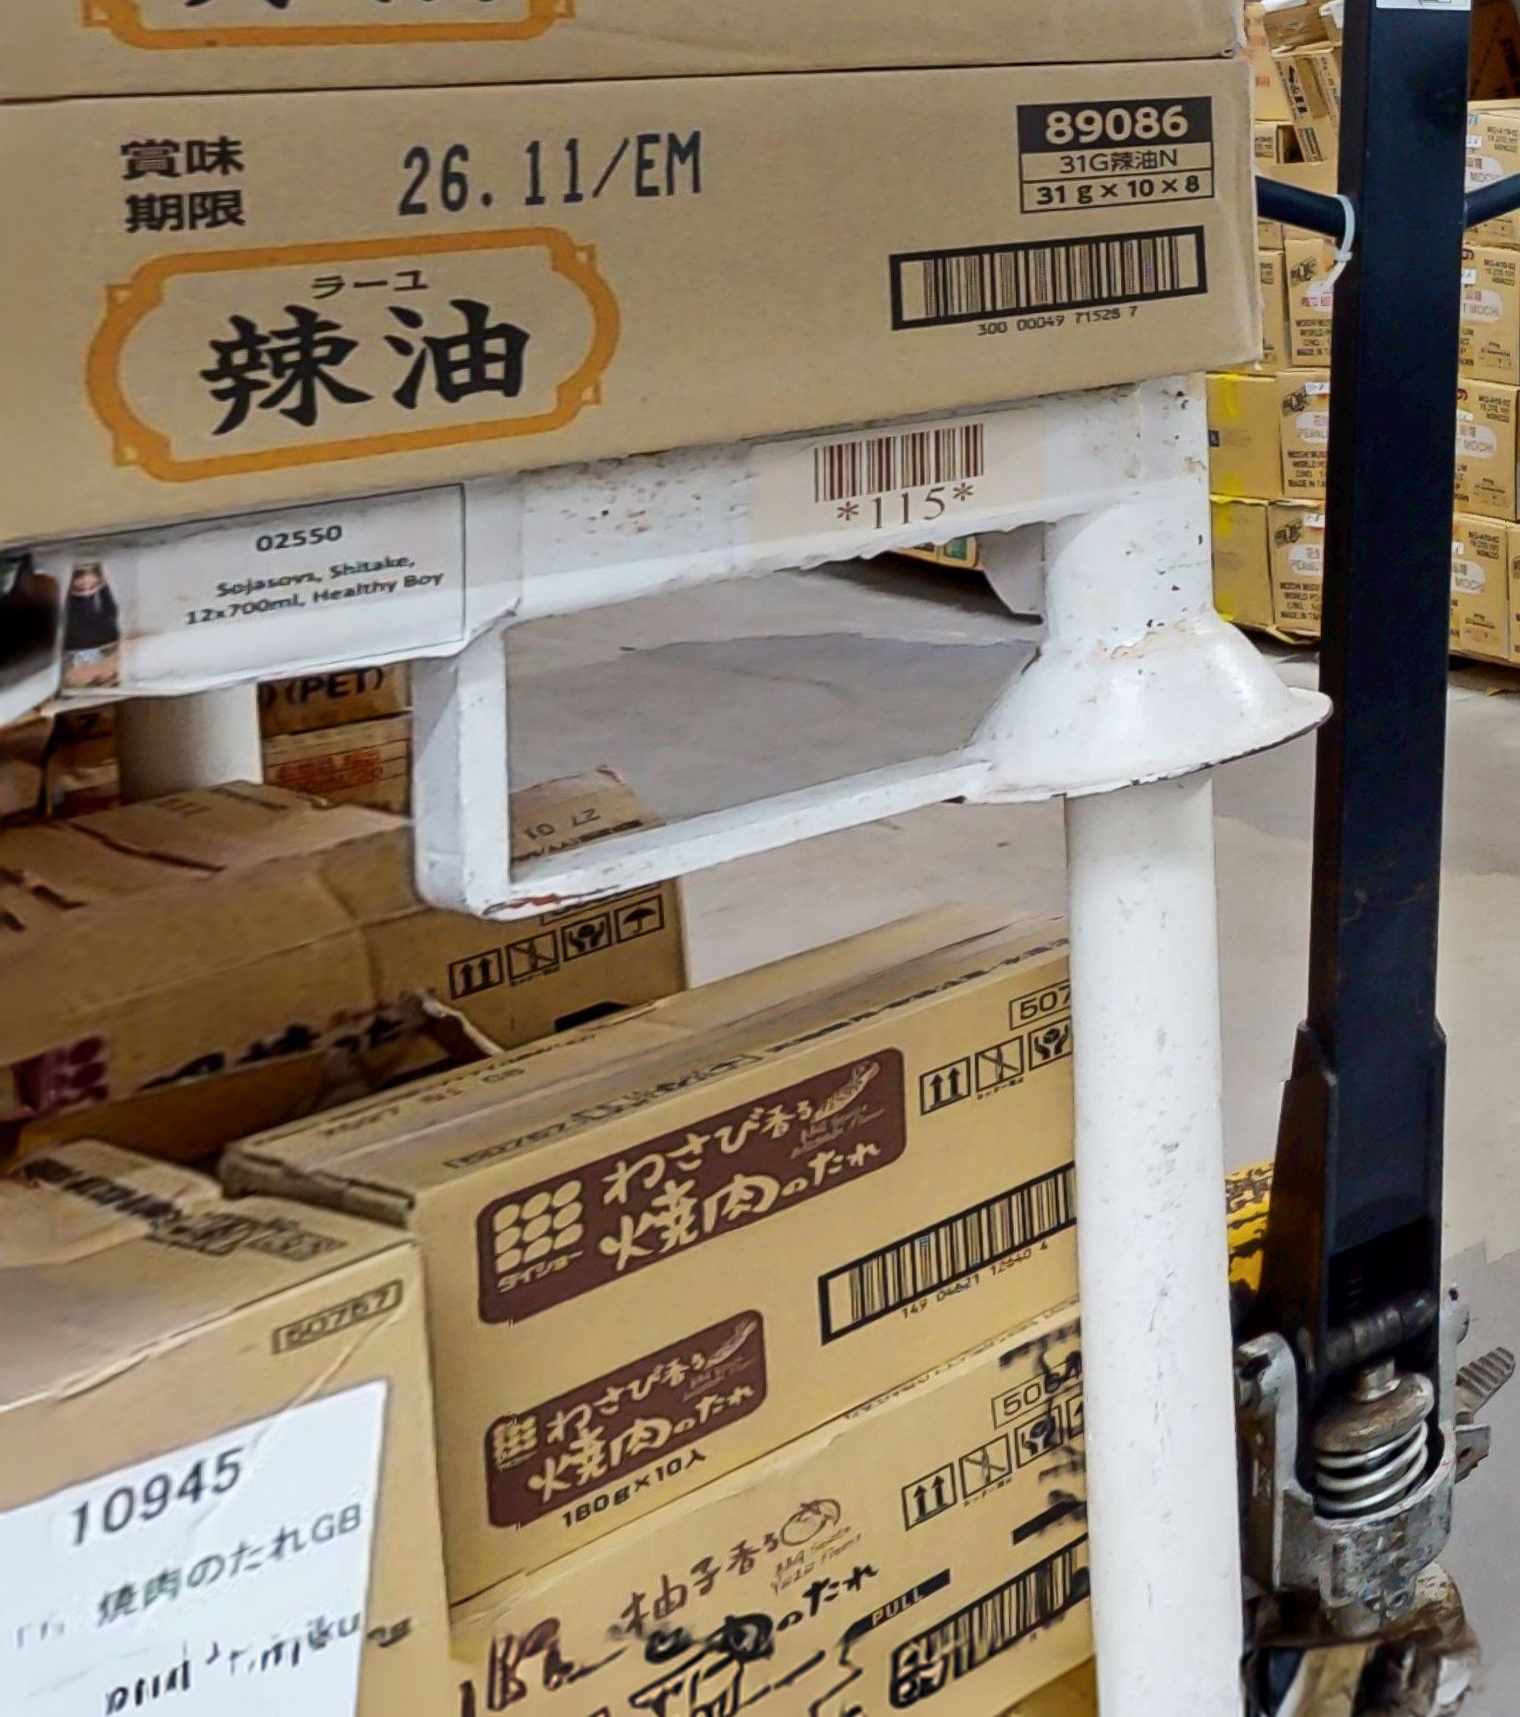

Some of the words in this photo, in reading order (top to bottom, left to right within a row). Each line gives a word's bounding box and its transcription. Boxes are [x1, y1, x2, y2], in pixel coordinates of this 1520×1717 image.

[1045, 105, 1189, 144] 89086
[120, 136, 244, 180] 賞味
[399, 130, 702, 217] 26.11/EM
[125, 191, 245, 233] 期限
[311, 269, 430, 299] ラーユ
[199, 298, 530, 436] 辣油
[256, 525, 343, 552] 02550
[312, 580, 397, 605] Healthy
[404, 572, 444, 588] Boy
[70, 1448, 244, 1546] 10945
